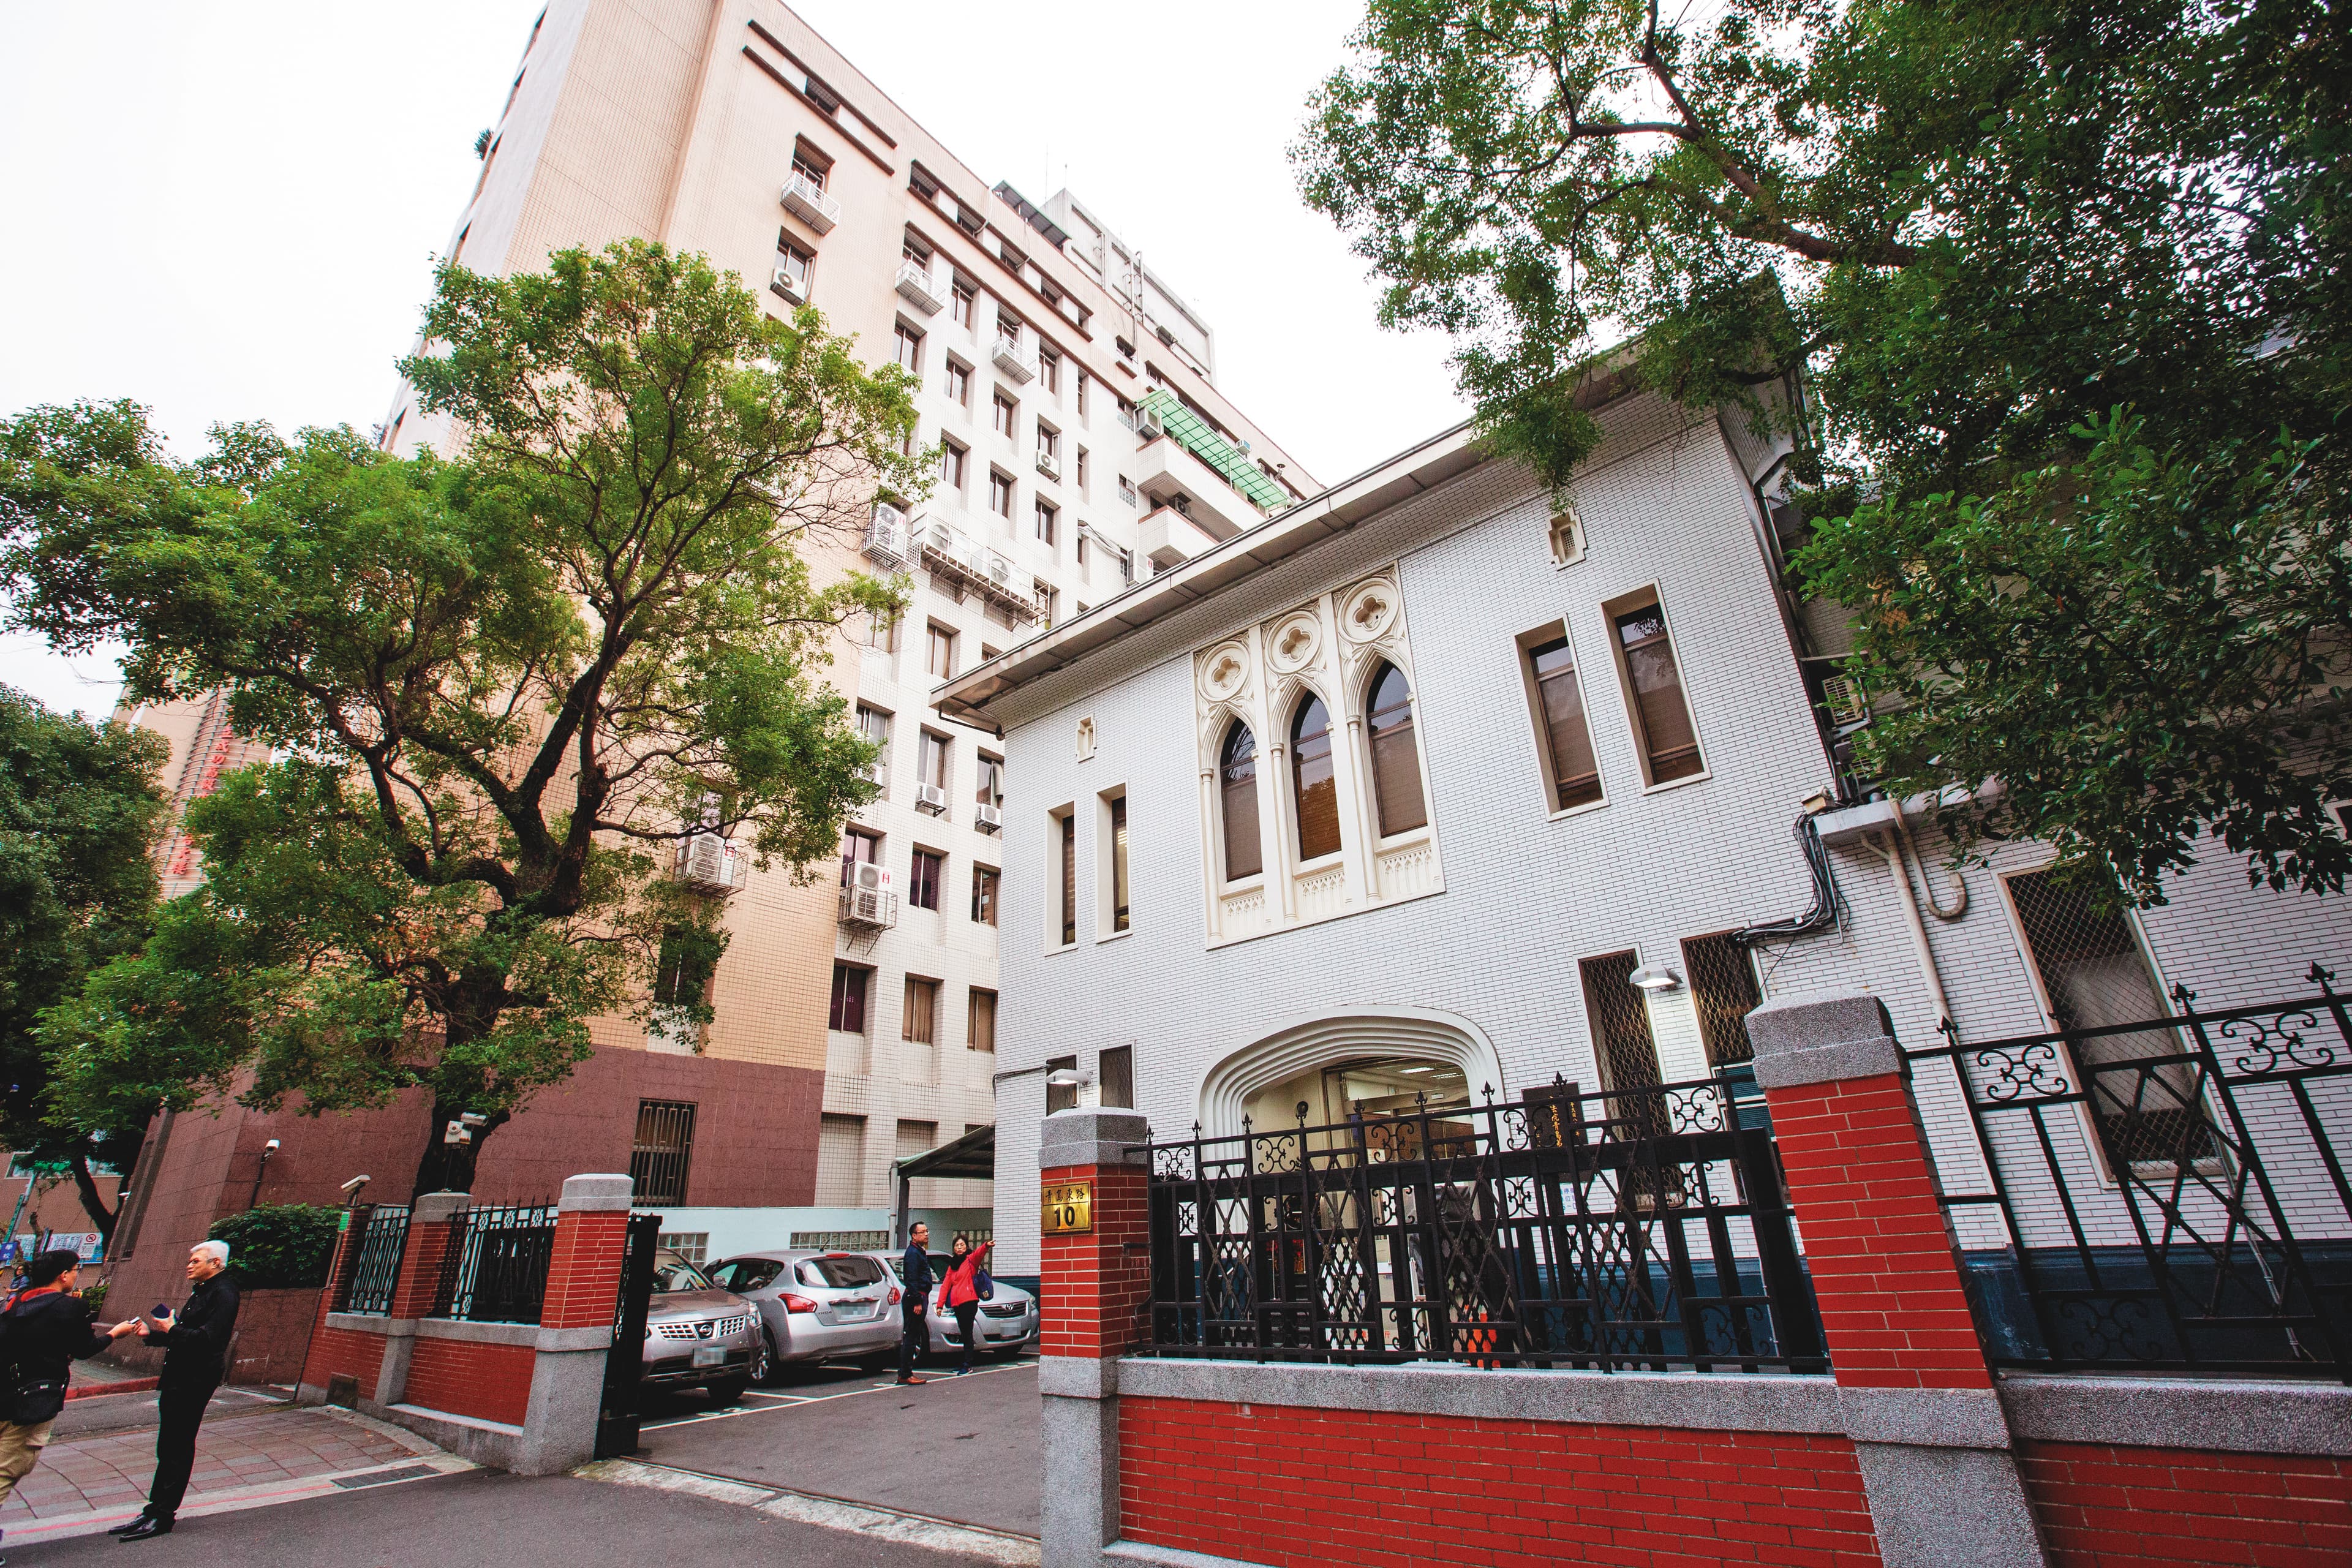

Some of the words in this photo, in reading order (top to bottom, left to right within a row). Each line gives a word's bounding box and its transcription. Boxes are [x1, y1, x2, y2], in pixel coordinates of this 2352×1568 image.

[1046, 1187, 1085, 1203] 青島東路
[1054, 1206, 1075, 1227] 10
